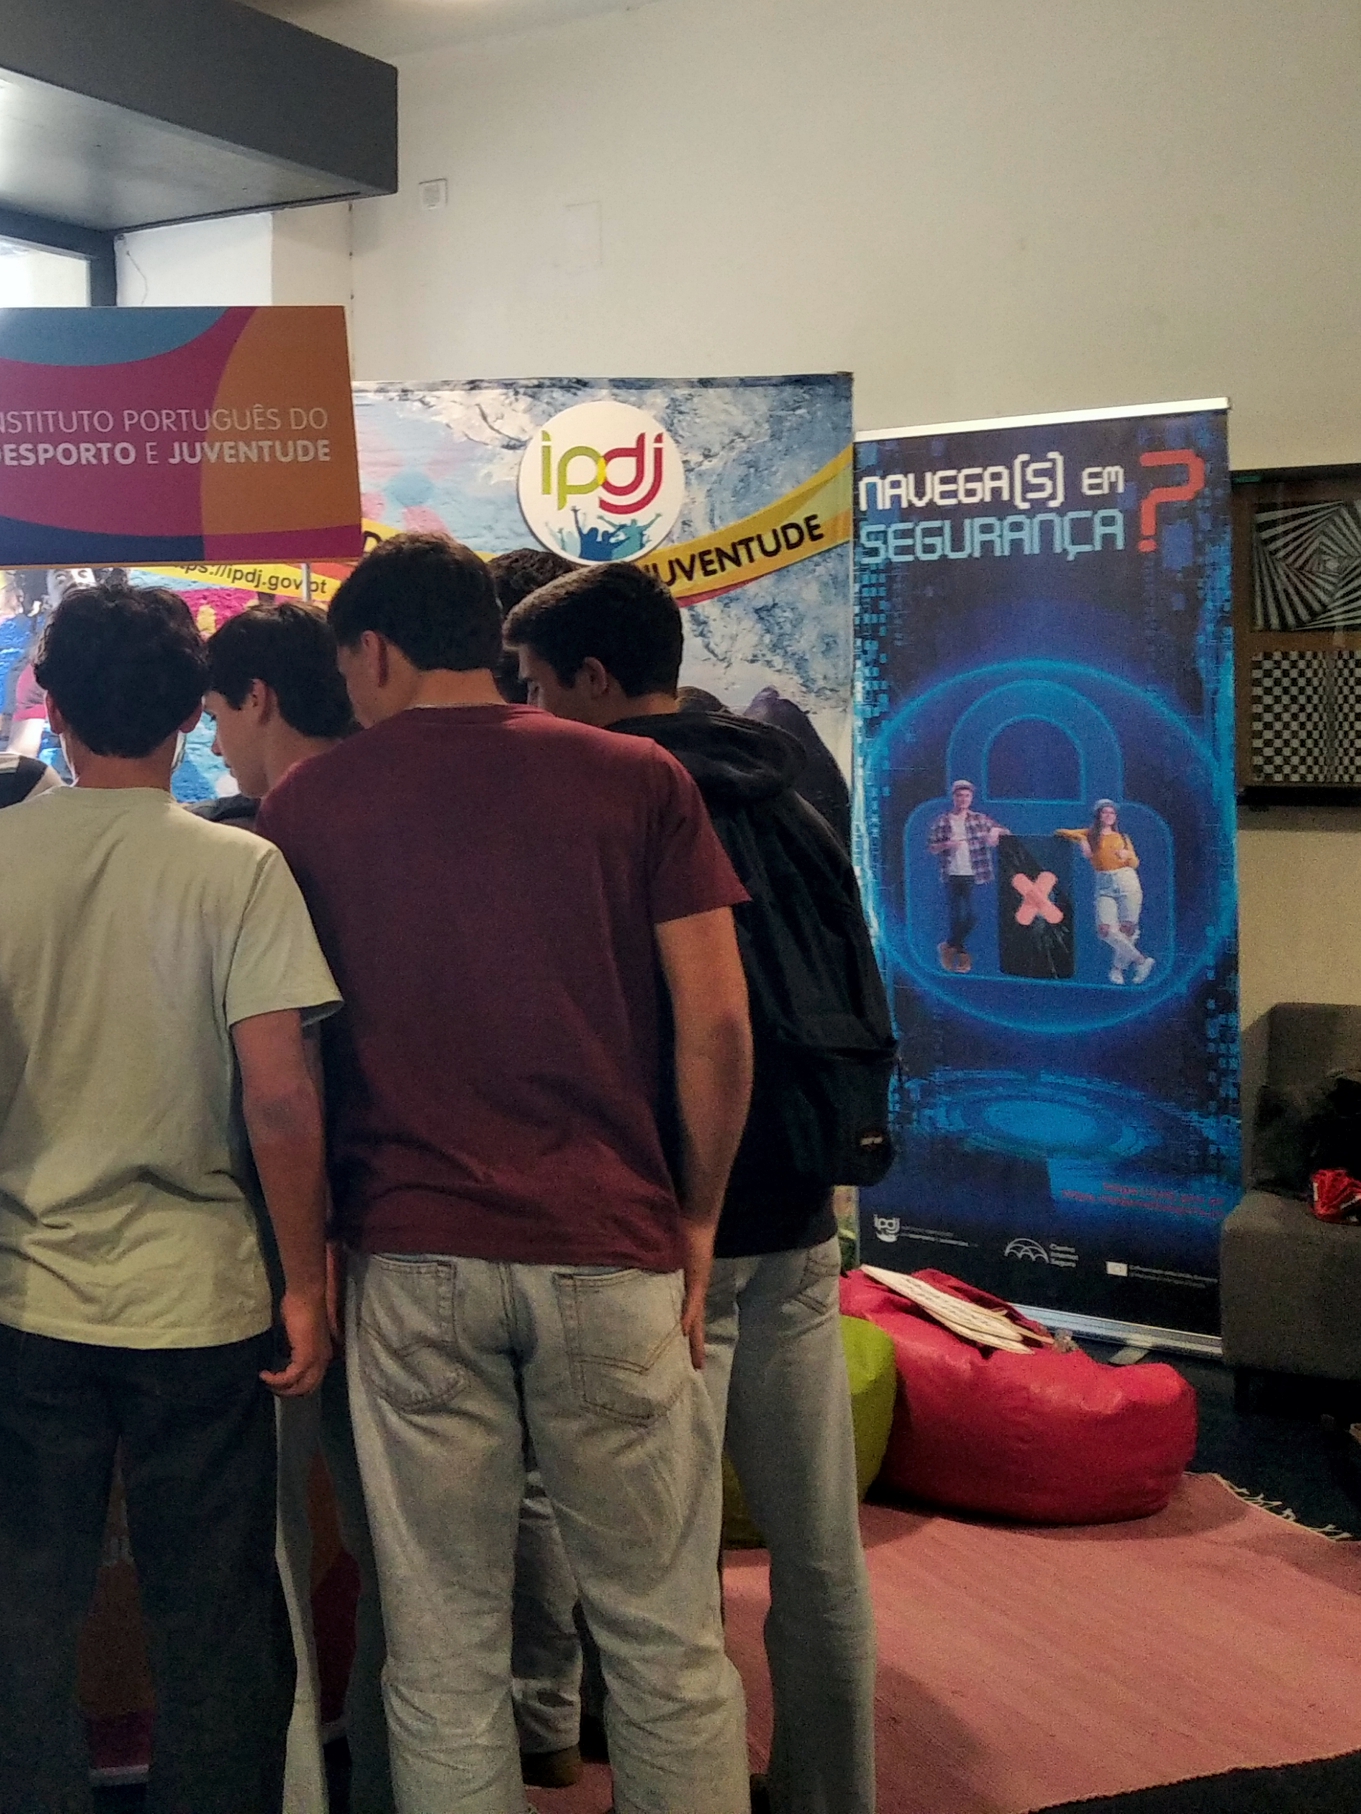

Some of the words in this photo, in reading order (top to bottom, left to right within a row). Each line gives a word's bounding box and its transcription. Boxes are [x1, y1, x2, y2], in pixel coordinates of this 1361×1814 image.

[123, 403, 282, 432] PORTUGUÊS
[290, 407, 328, 430] DO
[145, 442, 159, 465] E
[168, 440, 332, 465] JUVENTUDE
[541, 430, 665, 515] ipdj
[643, 514, 825, 588] UVENTUDE
[859, 509, 1125, 564] SEGURANÇA
